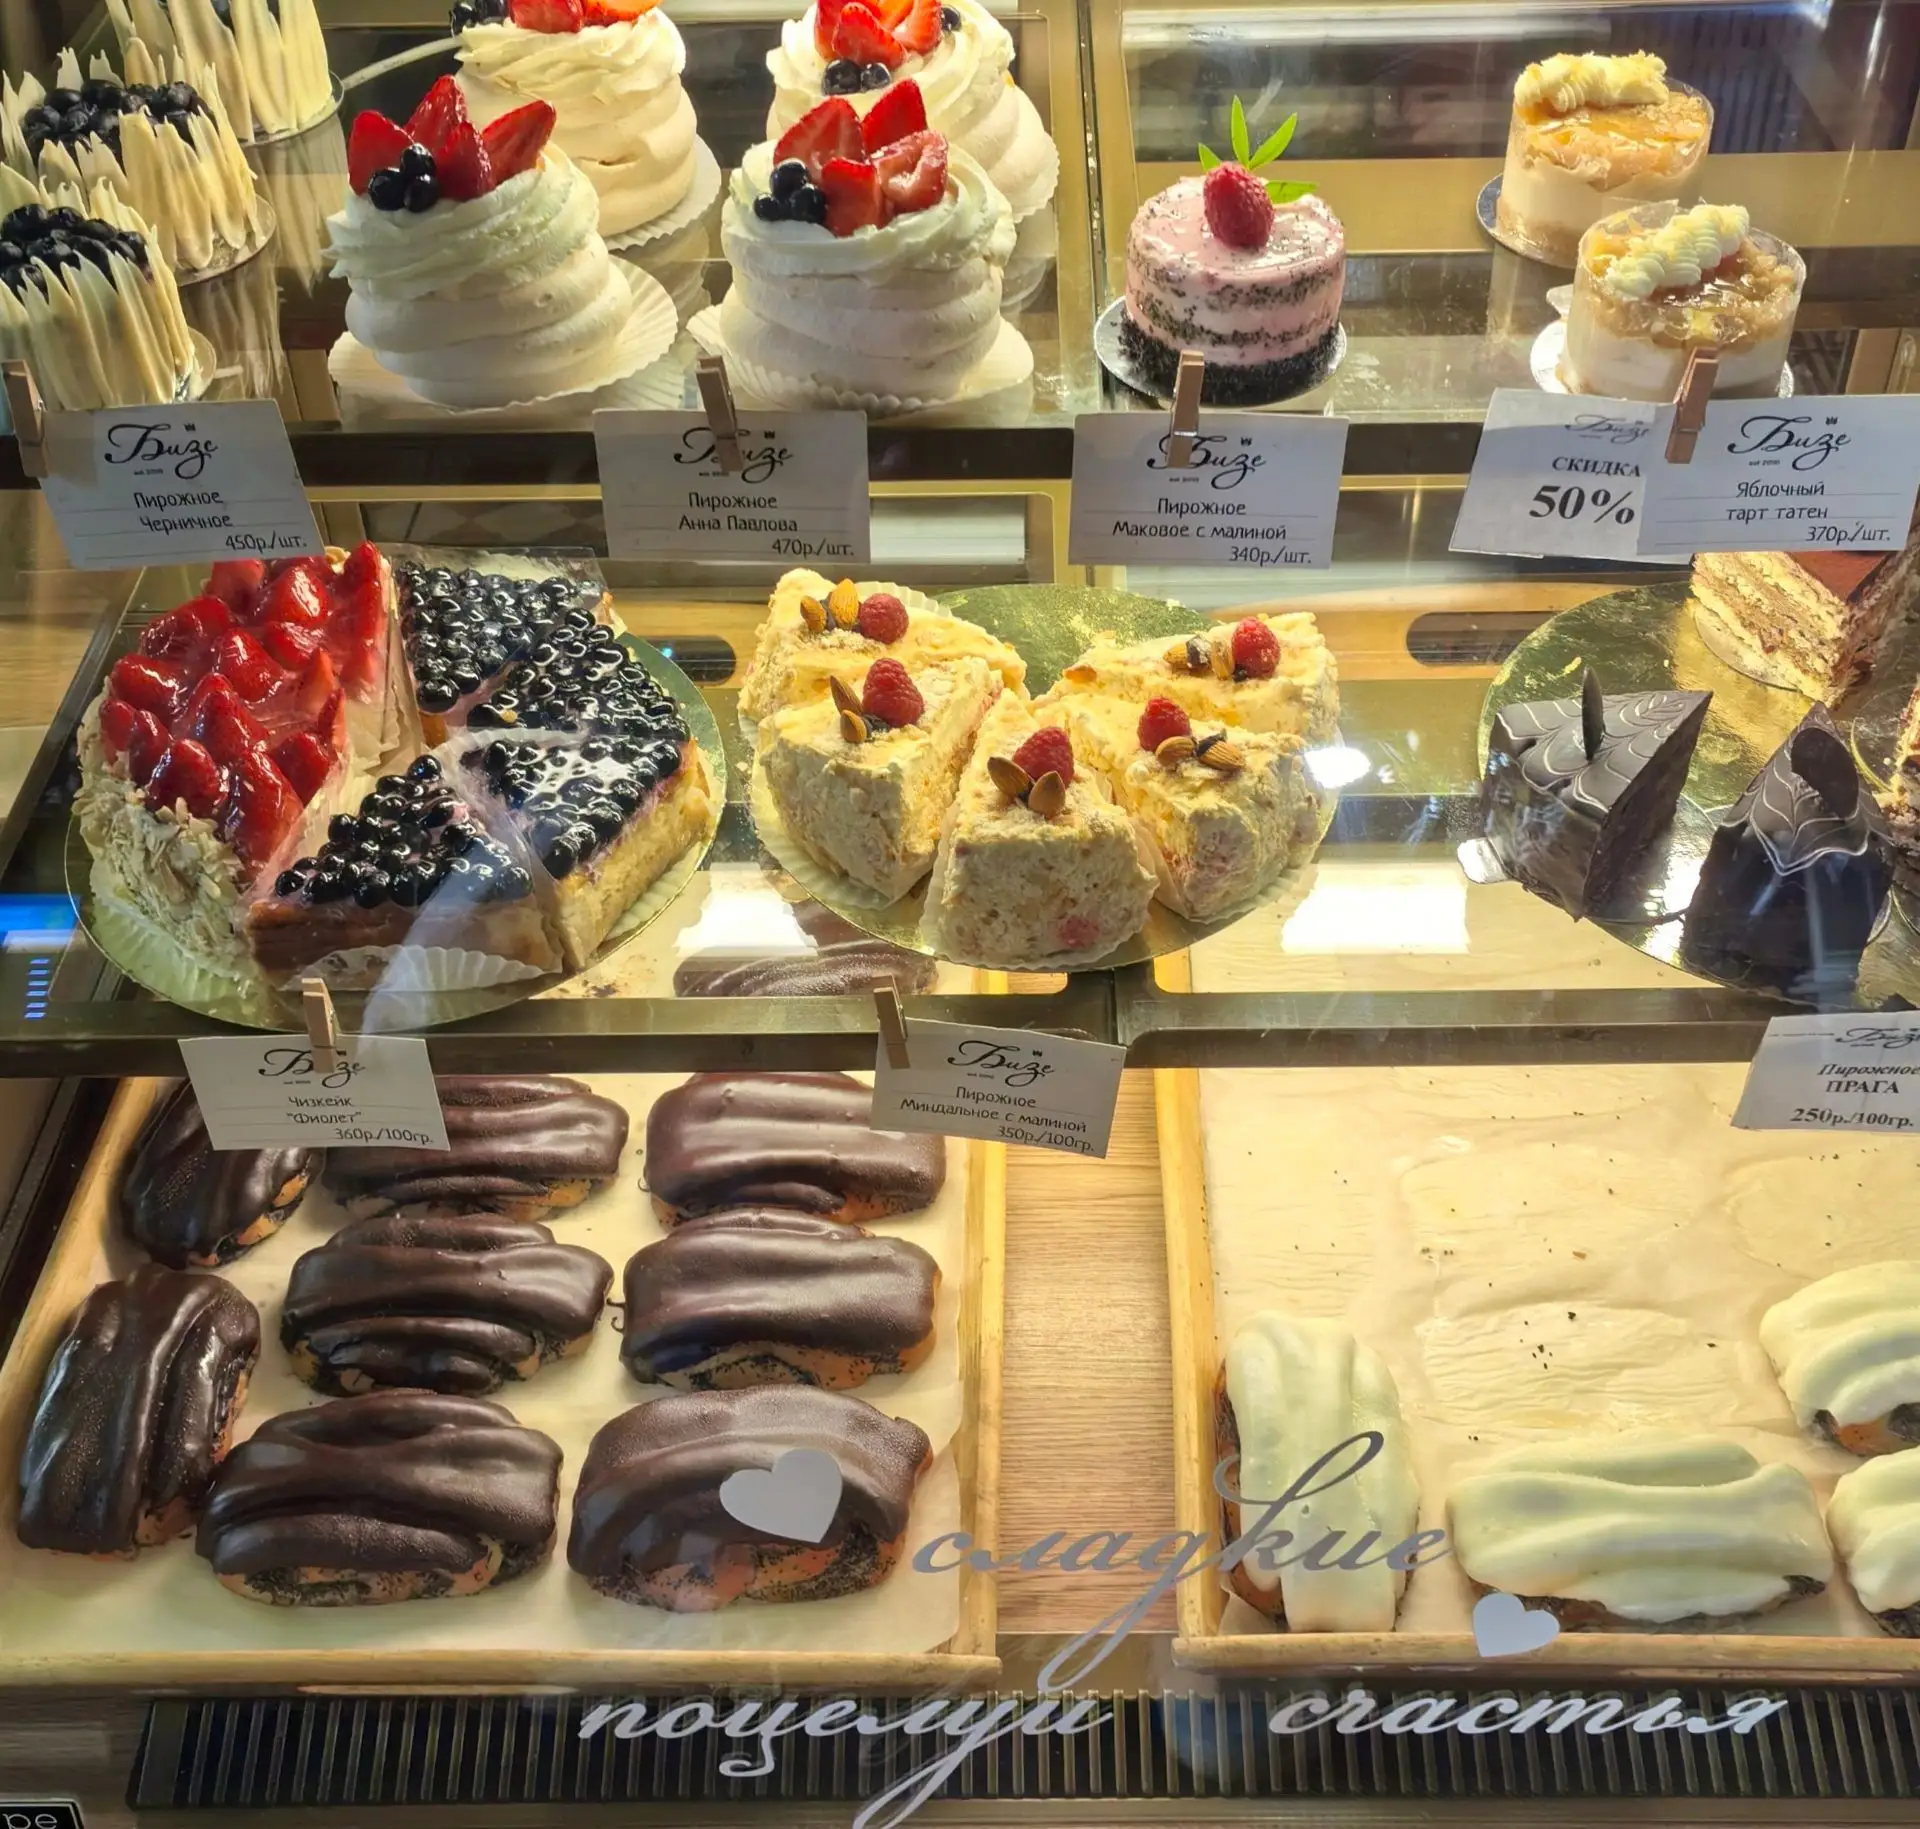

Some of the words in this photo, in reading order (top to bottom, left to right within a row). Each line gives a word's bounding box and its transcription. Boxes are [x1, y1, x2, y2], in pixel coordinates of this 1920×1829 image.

[105, 423, 219, 479] Бизе
[1727, 416, 1852, 471] Бизе
[1552, 456, 1641, 477] СКИДКА
[1736, 479, 1825, 498] Яблочный
[134, 490, 223, 511] Пирожное
[688, 492, 778, 512] Пирожное
[1157, 498, 1247, 519] Пирожное
[1529, 485, 1635, 525] 50%
[140, 513, 234, 536] Черничное
[678, 514, 721, 532] Анна
[727, 515, 798, 533] Павлова
[1726, 507, 1769, 524] тарт
[1775, 507, 1828, 520] татен
[1112, 520, 1189, 538] Маковое
[1196, 525, 1206, 538] с
[1211, 524, 1287, 540] малиной
[1805, 521, 1891, 545] 370р./шт.
[225, 530, 308, 553] 450р./шт.
[771, 538, 855, 559] 470р./шт.
[1228, 546, 1313, 568] 340р./шт.
[258, 1048, 366, 1089] Бзе
[947, 1040, 1056, 1088] Бизе
[955, 1086, 1037, 1108] Пирожное
[1825, 1079, 1900, 1095] ПРАГА
[288, 1095, 353, 1108] Чизкейк
[900, 1098, 999, 1120] Миндальное
[1004, 1112, 1015, 1122] с
[1018, 1115, 1087, 1133] малиной
[1789, 1107, 1915, 1129] 250р./100гр.
[998, 1125, 1095, 1153] 350р./100гр.
[911, 1430, 1452, 1692] сладкие
[1269, 1688, 1789, 1735] счастья
